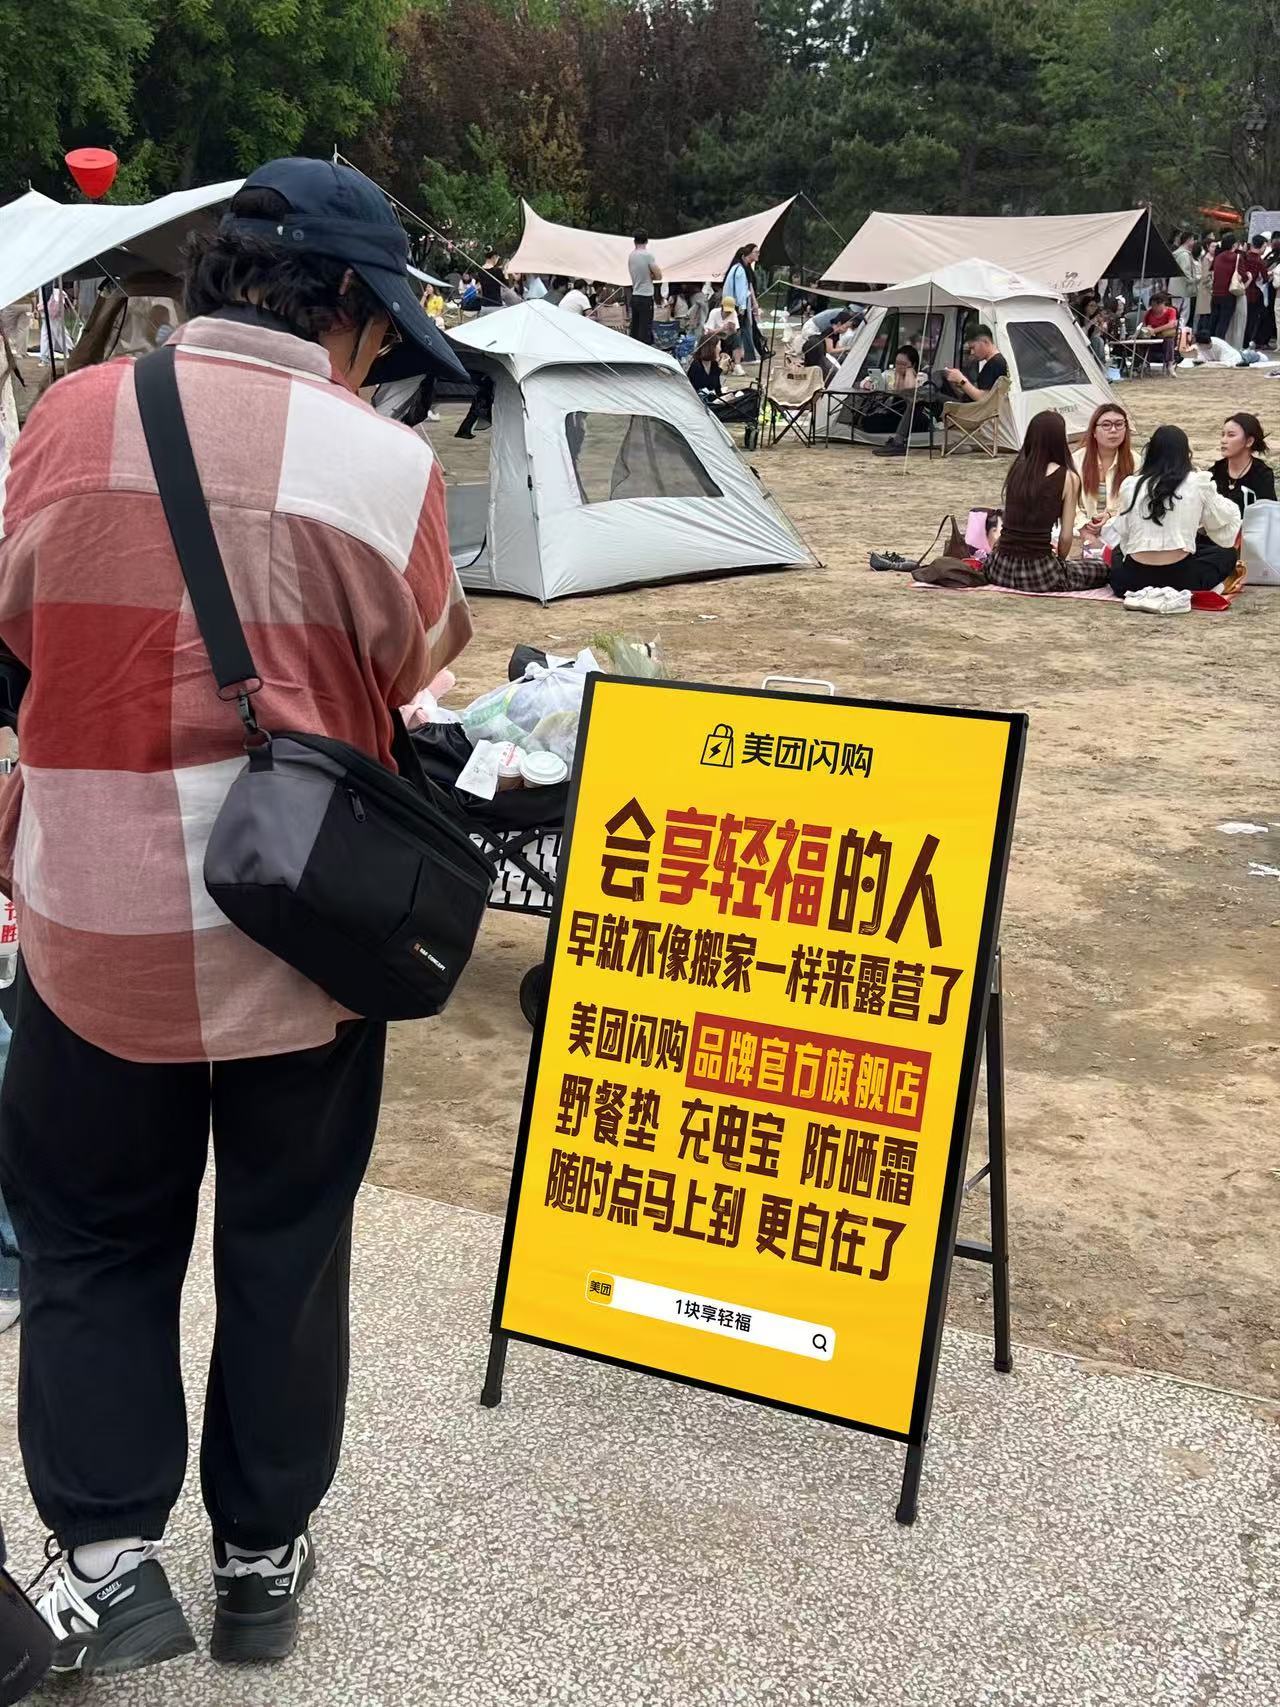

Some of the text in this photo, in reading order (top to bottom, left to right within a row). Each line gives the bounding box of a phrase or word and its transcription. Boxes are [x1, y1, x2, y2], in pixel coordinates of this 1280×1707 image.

[742, 733, 873, 778] 美团闪购
[567, 911, 963, 1025] 早就不像搬家一样来露营了
[555, 1074, 918, 1206] 野餐垫 充电宝 防晒霜
[545, 1148, 906, 1281] 随时点马上到 更自在了
[589, 1281, 612, 1297] 美团
[675, 1299, 752, 1332] 1块享轻福
[96, 1580, 122, 1601] CAMEL
